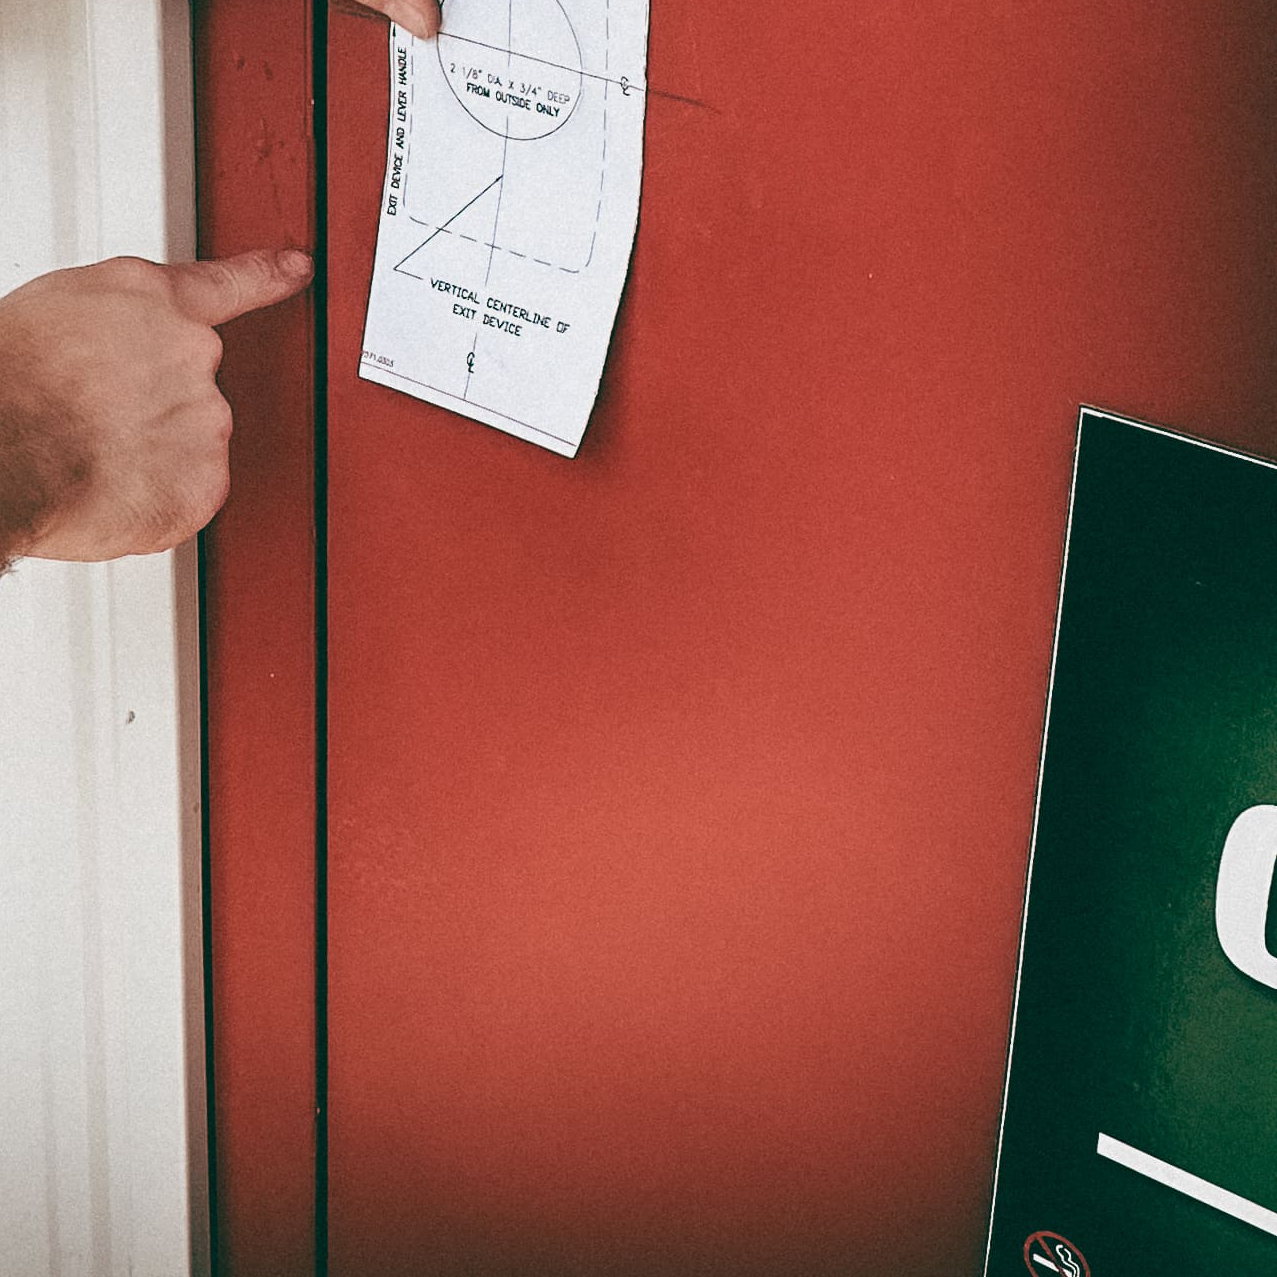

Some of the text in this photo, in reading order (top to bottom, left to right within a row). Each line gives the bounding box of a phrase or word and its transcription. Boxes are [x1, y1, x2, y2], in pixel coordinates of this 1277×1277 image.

[450, 62, 456, 73] 2
[547, 90, 571, 105] DEEP
[466, 82, 560, 118] FROM OUTSIDE ONLY
[386, 46, 408, 216] EXIT DEVICE AND LEVER HANDLE
[429, 277, 571, 334] VERTICAL CENTERLINE OF
[452, 303, 524, 337] EXIT DEVICE
